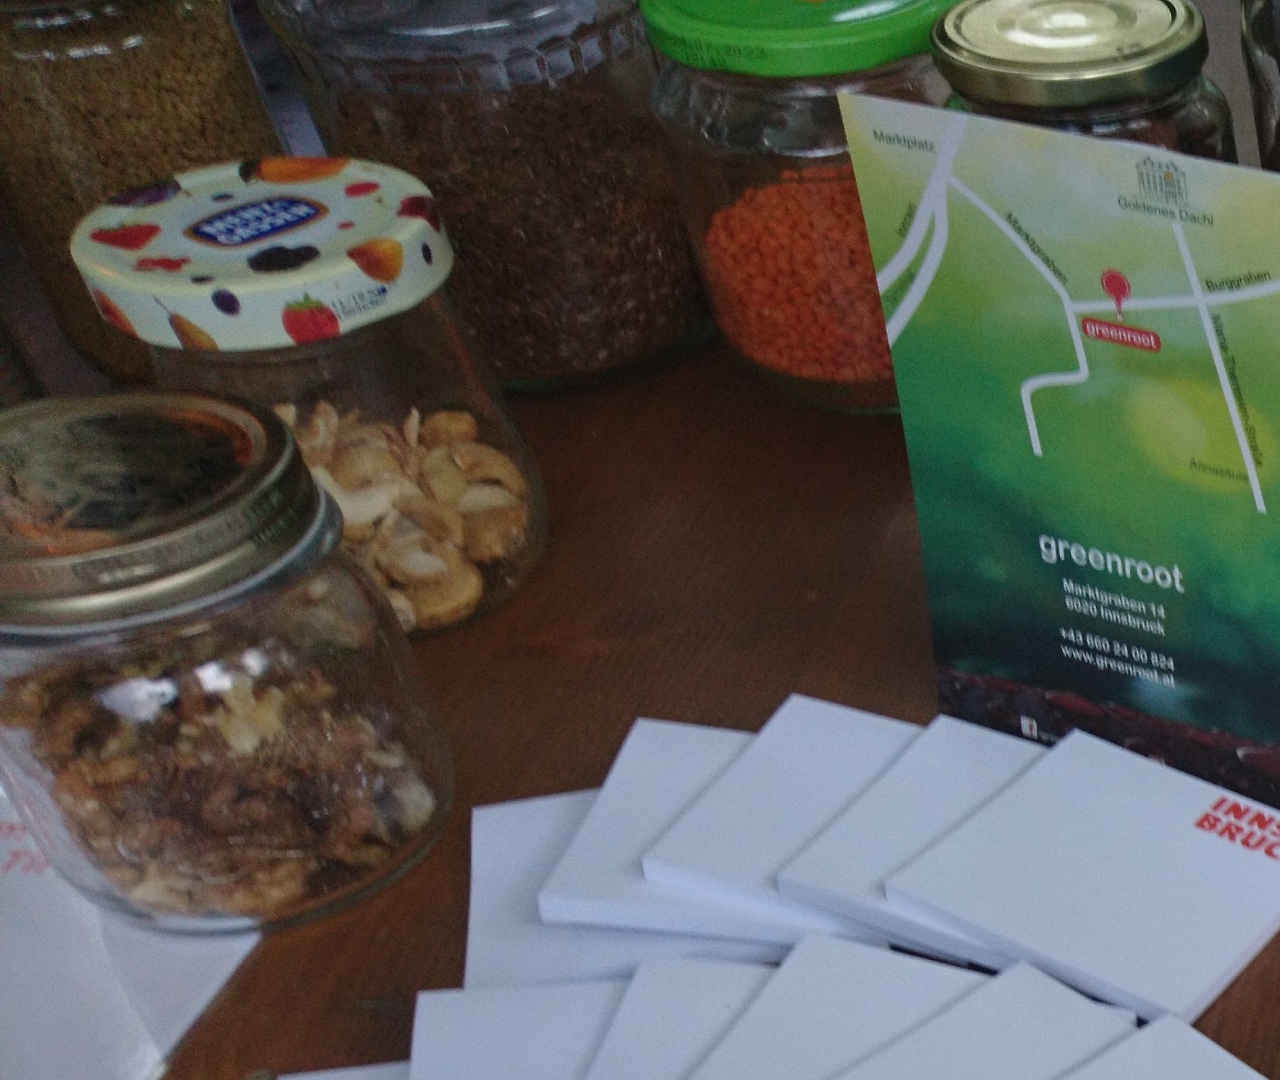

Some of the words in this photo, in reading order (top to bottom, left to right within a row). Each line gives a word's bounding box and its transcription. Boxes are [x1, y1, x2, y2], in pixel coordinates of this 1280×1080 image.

[873, 129, 936, 153] Marktplatz
[1117, 196, 1176, 220] Goldenes
[1179, 209, 1215, 227] Dachl
[1205, 270, 1272, 292] Burggraben
[1085, 320, 1157, 350] greenroot
[1039, 533, 1185, 594] greenroot
[1062, 577, 1147, 615] Marktgraben
[1150, 601, 1166, 620] 14
[1065, 594, 1098, 618] 6020
[1100, 604, 1166, 637] Innsbruck
[1059, 626, 1084, 647] +43
[1060, 644, 1176, 690] www.greenroot.at
